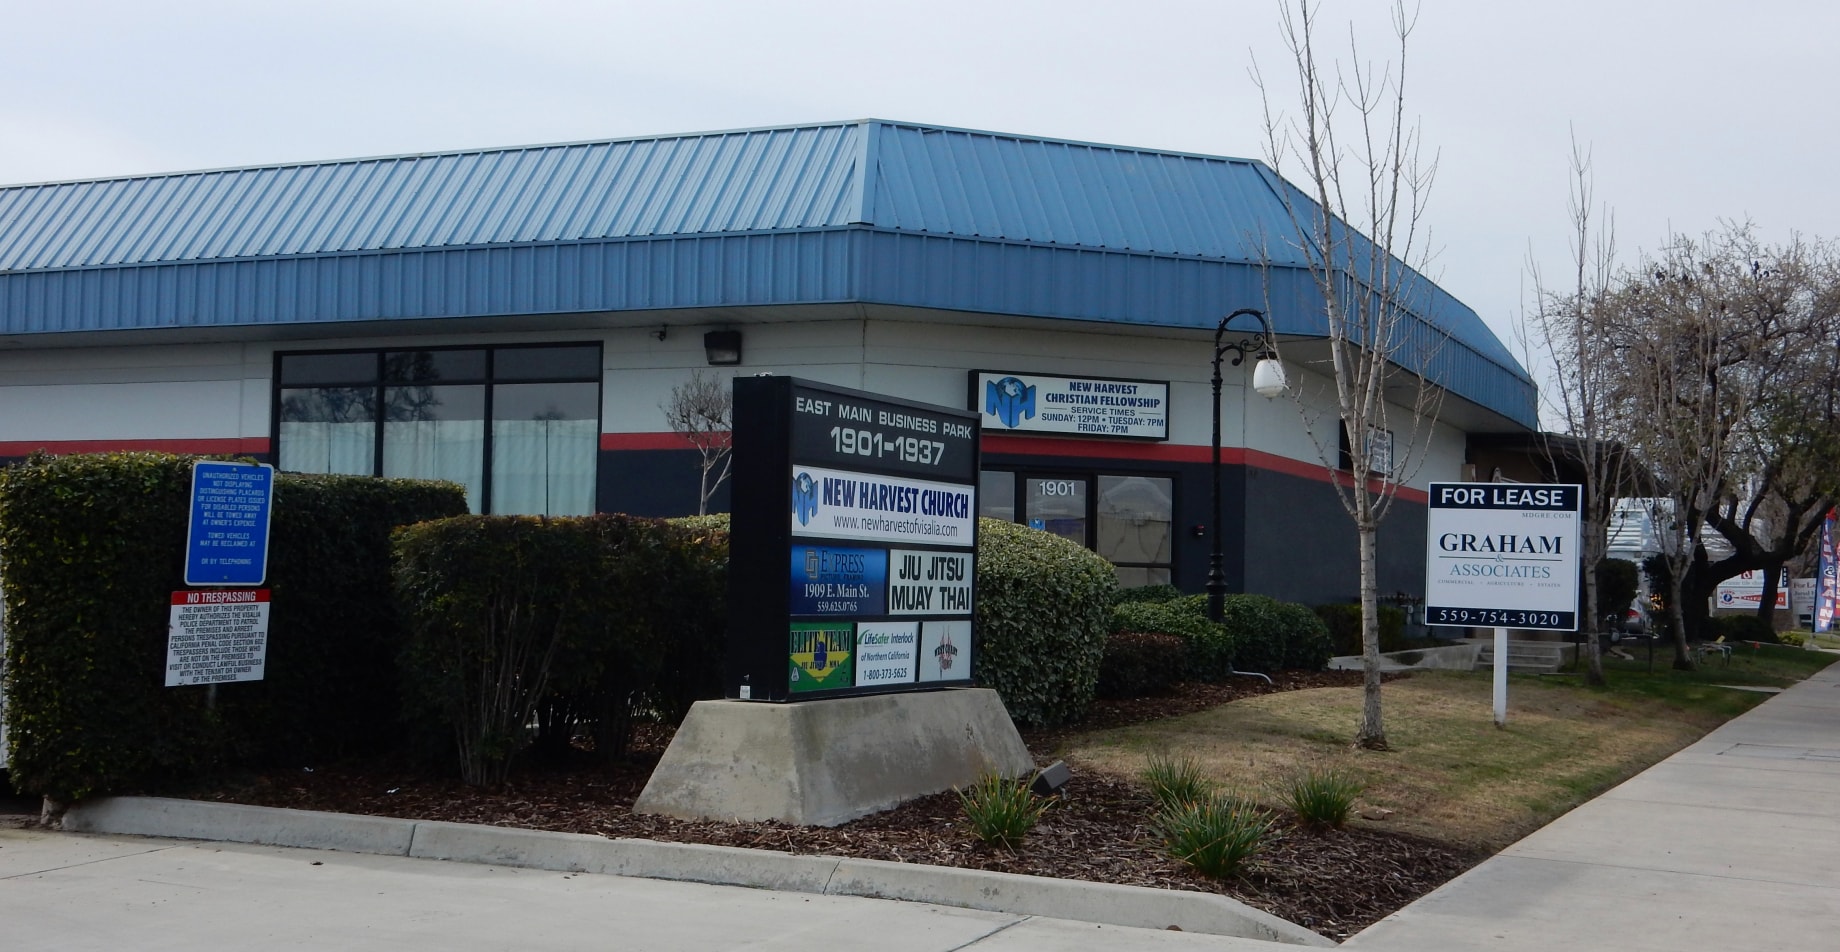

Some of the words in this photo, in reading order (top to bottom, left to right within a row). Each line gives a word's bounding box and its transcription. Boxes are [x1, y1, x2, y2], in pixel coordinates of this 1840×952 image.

[1070, 382, 1092, 392] NEW
[1094, 383, 1138, 395] HARVEST
[1046, 393, 1098, 405] CHRISTIAN
[1100, 396, 1160, 408] FELLOWSHIP
[796, 397, 831, 416] EAST
[839, 404, 872, 422] MAIN
[879, 411, 936, 433] BUSINESS
[943, 423, 971, 439] PARK
[1071, 407, 1107, 415] SERVICE
[1042, 413, 1075, 422] SUNDAY:
[1147, 419, 1163, 427] 7PM
[1078, 424, 1109, 432] FRIDAY:
[1111, 425, 1128, 433] 7PM
[831, 427, 944, 465] 1901-1937
[203, 472, 239, 480] UNAUTHORIZED
[1039, 482, 1075, 496] 1901
[823, 477, 856, 508] NEW
[860, 481, 919, 514] HARVEST
[921, 490, 968, 519] CHURCH
[1442, 488, 1485, 504] FOR
[1493, 489, 1563, 506] LEASE
[1440, 533, 1563, 554] GRAHAM
[821, 550, 864, 574] EXPRESS
[1495, 554, 1504, 562] &
[899, 555, 921, 581] JIU
[928, 557, 964, 581] JITSU
[1450, 564, 1550, 579] ASSOCIATES
[187, 593, 199, 603] NO
[202, 592, 256, 602] TRESPASSING
[805, 584, 825, 598] 1909
[827, 584, 835, 597] E.
[837, 584, 857, 598] Main
[859, 585, 869, 598] St.
[892, 586, 933, 610] MUAY
[940, 587, 969, 610] THAI
[817, 602, 857, 612] 559.625.0765
[1440, 610, 1559, 625] 559-754-3020
[824, 630, 850, 652] TEAM
[865, 632, 889, 644] LifeSafer
[891, 632, 913, 643] Interlock
[861, 653, 866, 661] of
[889, 652, 909, 660] California
[864, 668, 907, 680] 1-800-373-5625
